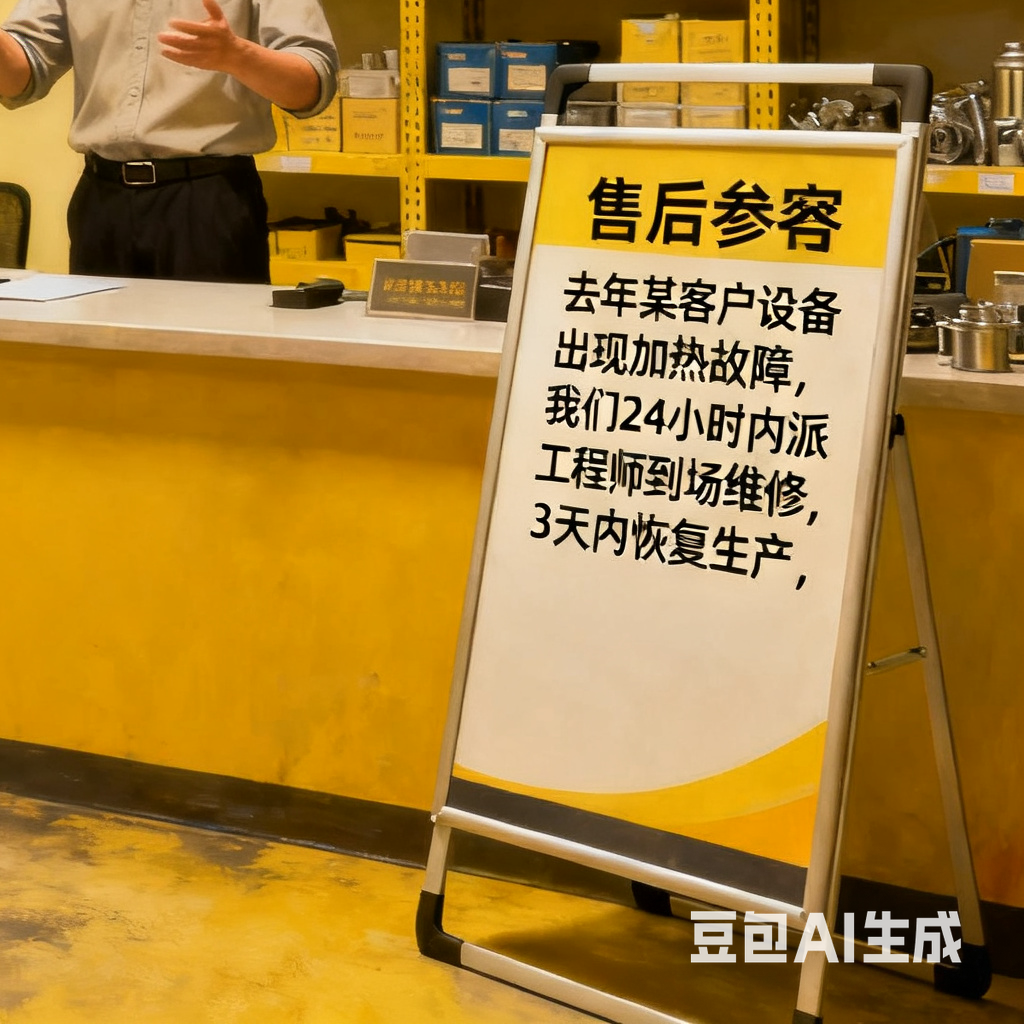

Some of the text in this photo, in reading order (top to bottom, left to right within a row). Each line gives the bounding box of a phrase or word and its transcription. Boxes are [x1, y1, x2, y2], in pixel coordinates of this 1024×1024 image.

[563, 271, 842, 336] 去年某客户设备
[544, 384, 830, 460] 我们24小时内派
